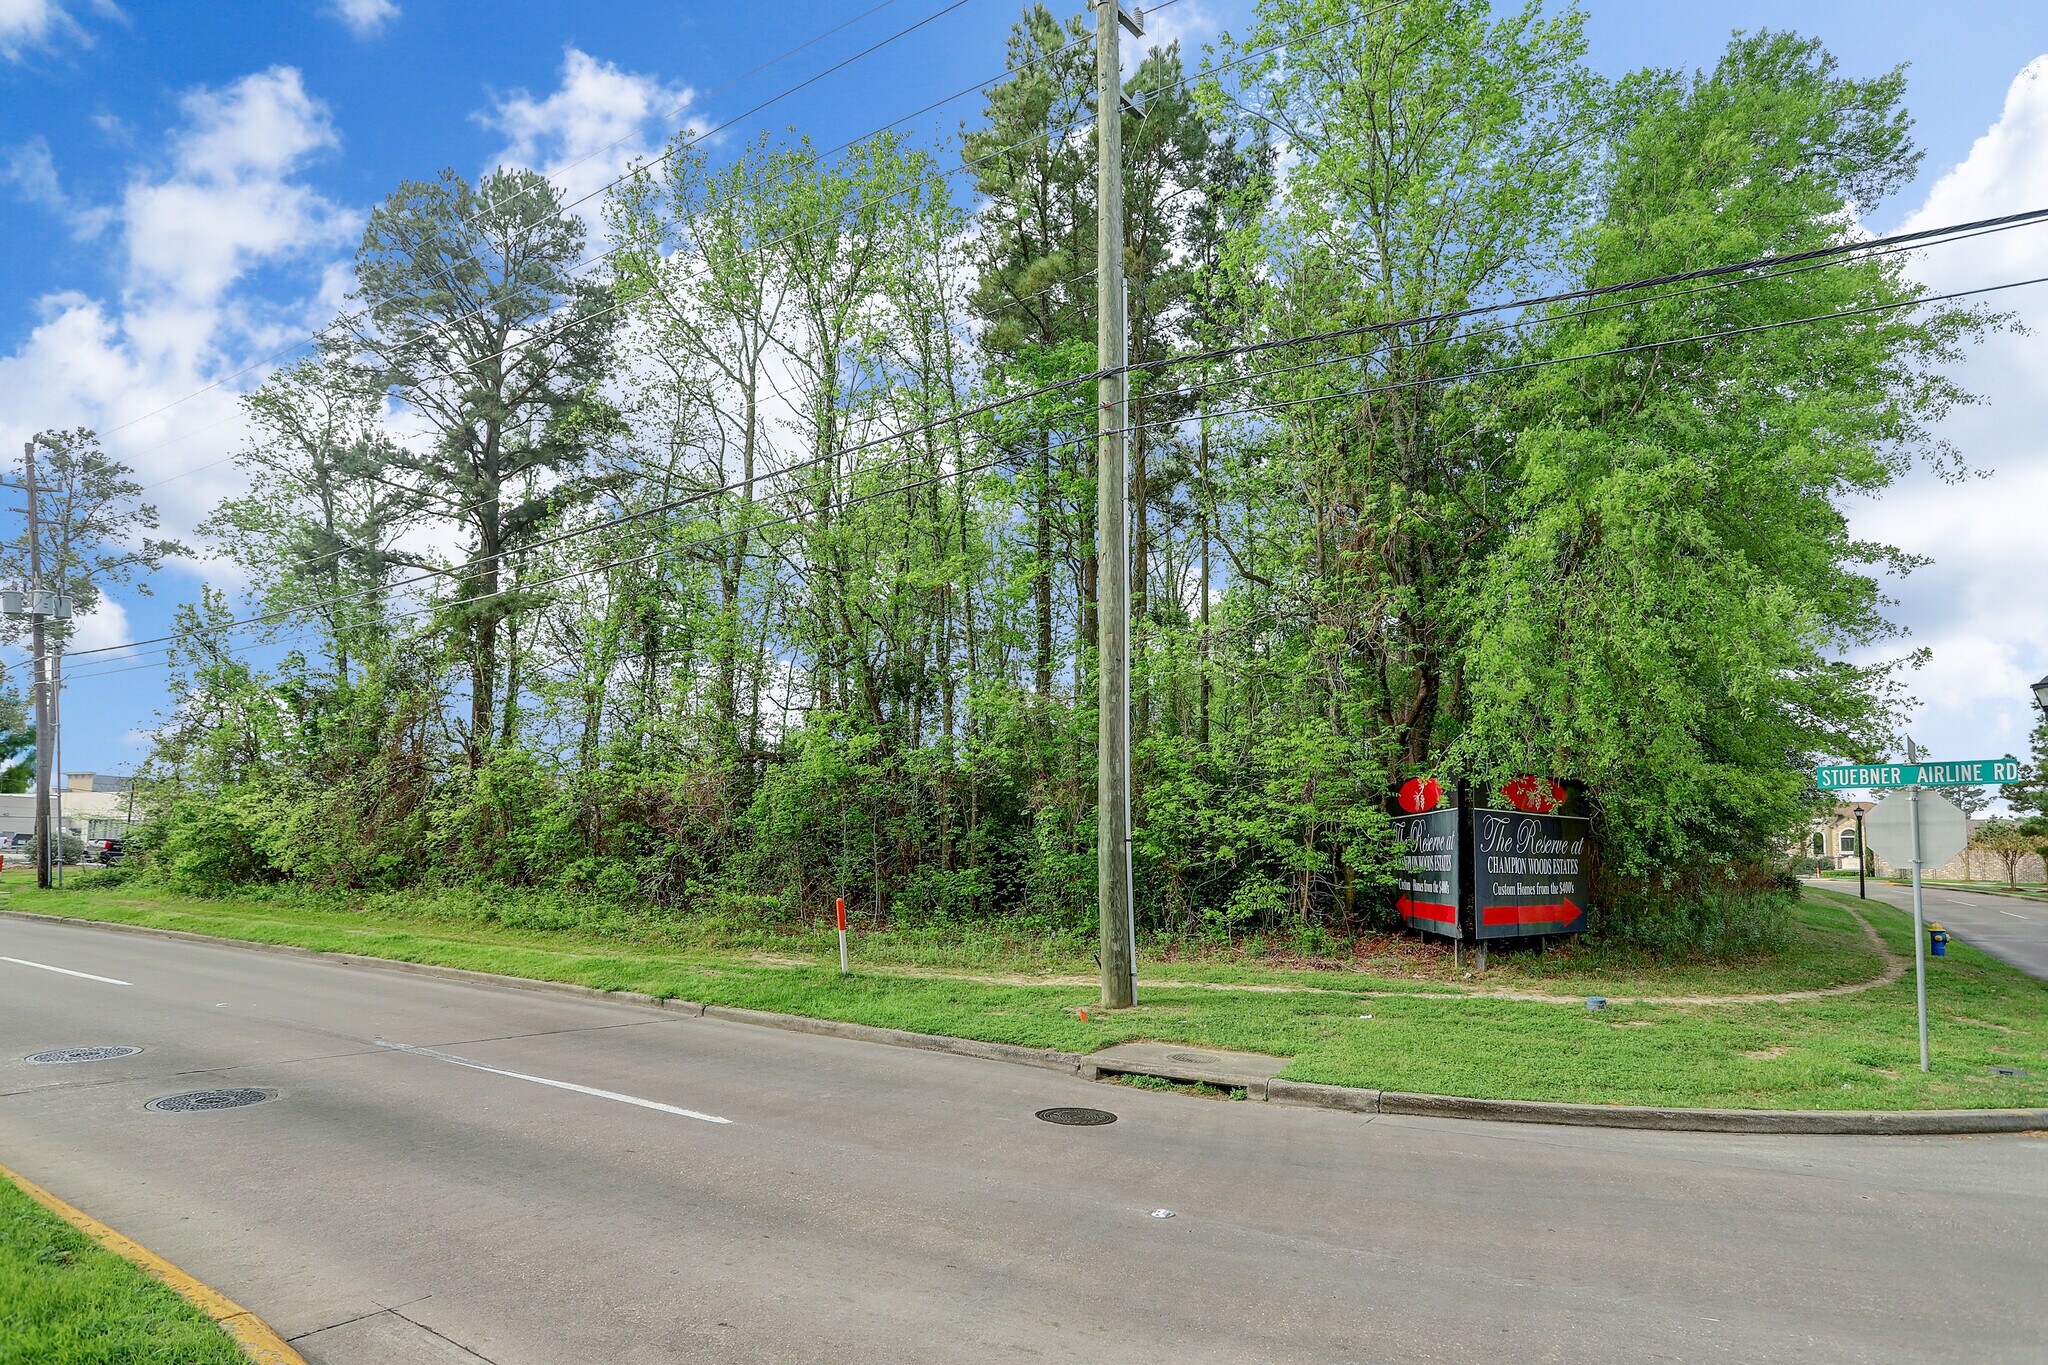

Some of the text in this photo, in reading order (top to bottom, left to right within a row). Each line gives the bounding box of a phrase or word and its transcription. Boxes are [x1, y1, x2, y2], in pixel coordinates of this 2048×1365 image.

[1822, 761, 2018, 787] STUEBNER AIRLINE RD
[1410, 819, 1445, 853] Reserve
[1446, 831, 1455, 850] at
[1480, 814, 1585, 855] The Reserve at
[1487, 855, 1579, 875] CHAMPION WOODS ESTATES
[1492, 881, 1516, 896] Custom
[1516, 882, 1536, 896] Homes
[1536, 881, 1550, 895] from
[1550, 881, 1559, 895] the
